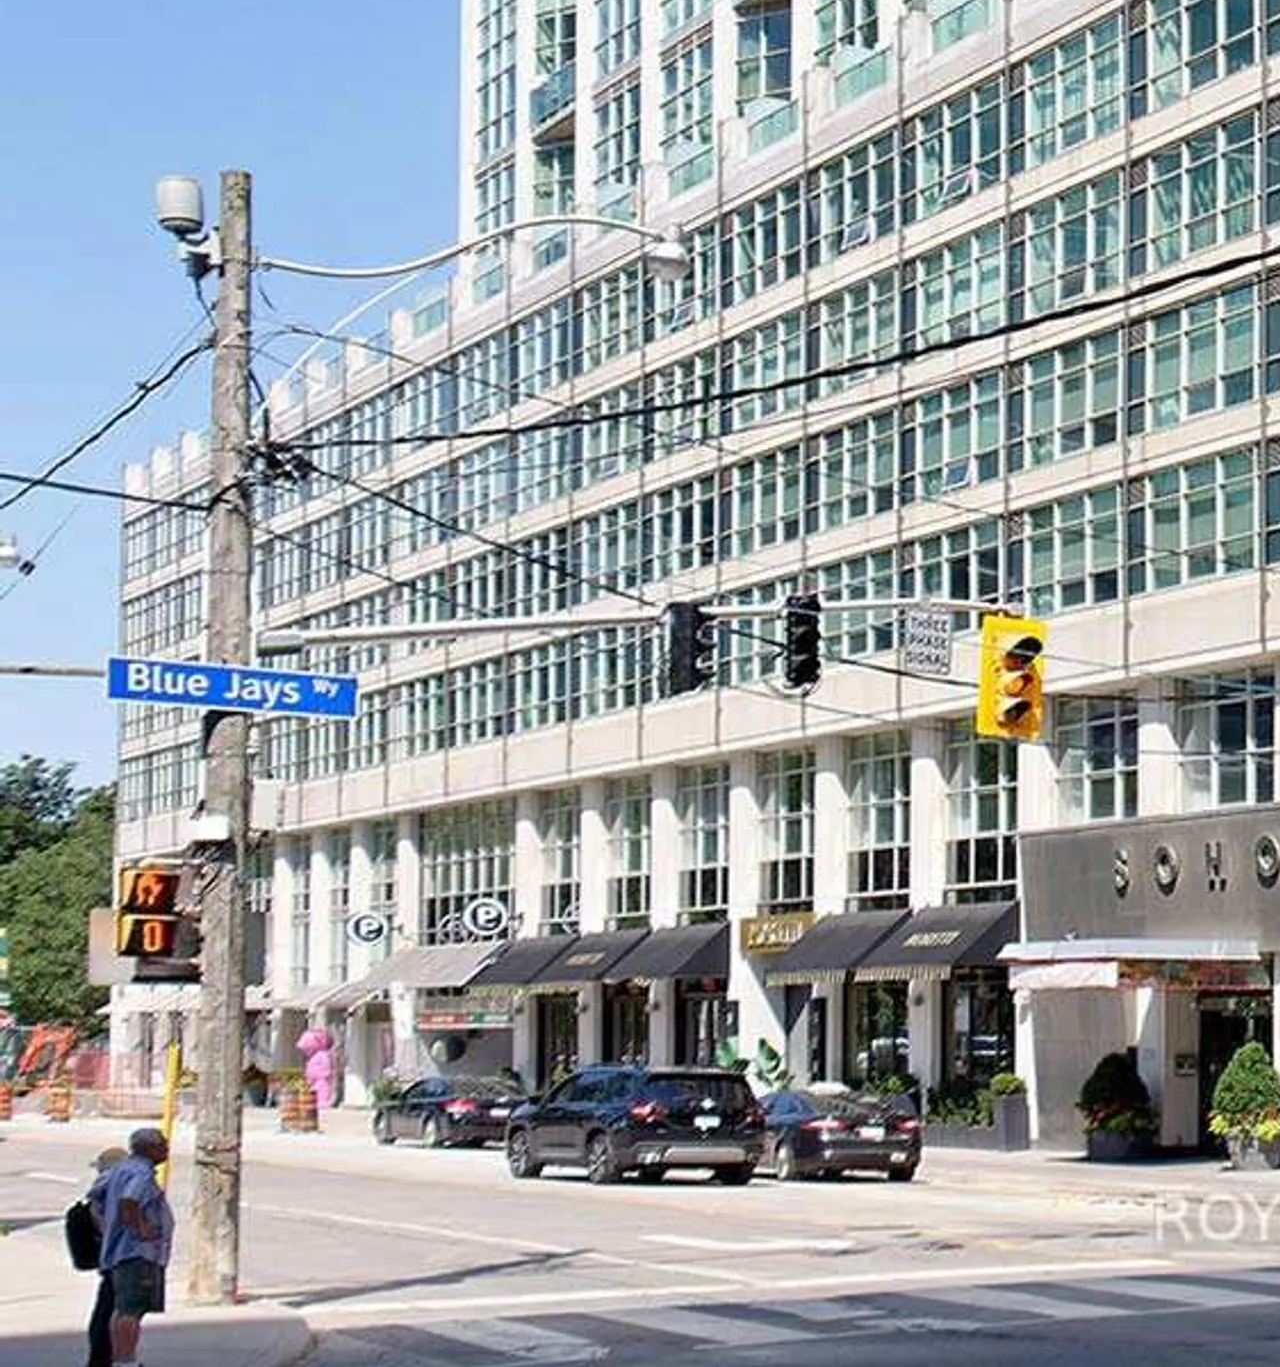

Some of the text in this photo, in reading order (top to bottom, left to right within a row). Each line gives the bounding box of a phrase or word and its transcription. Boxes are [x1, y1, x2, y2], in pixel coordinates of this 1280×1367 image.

[910, 615, 948, 633] THREE
[127, 663, 340, 708] Blue Jays Wy
[1113, 836, 1280, 896] SOHO
